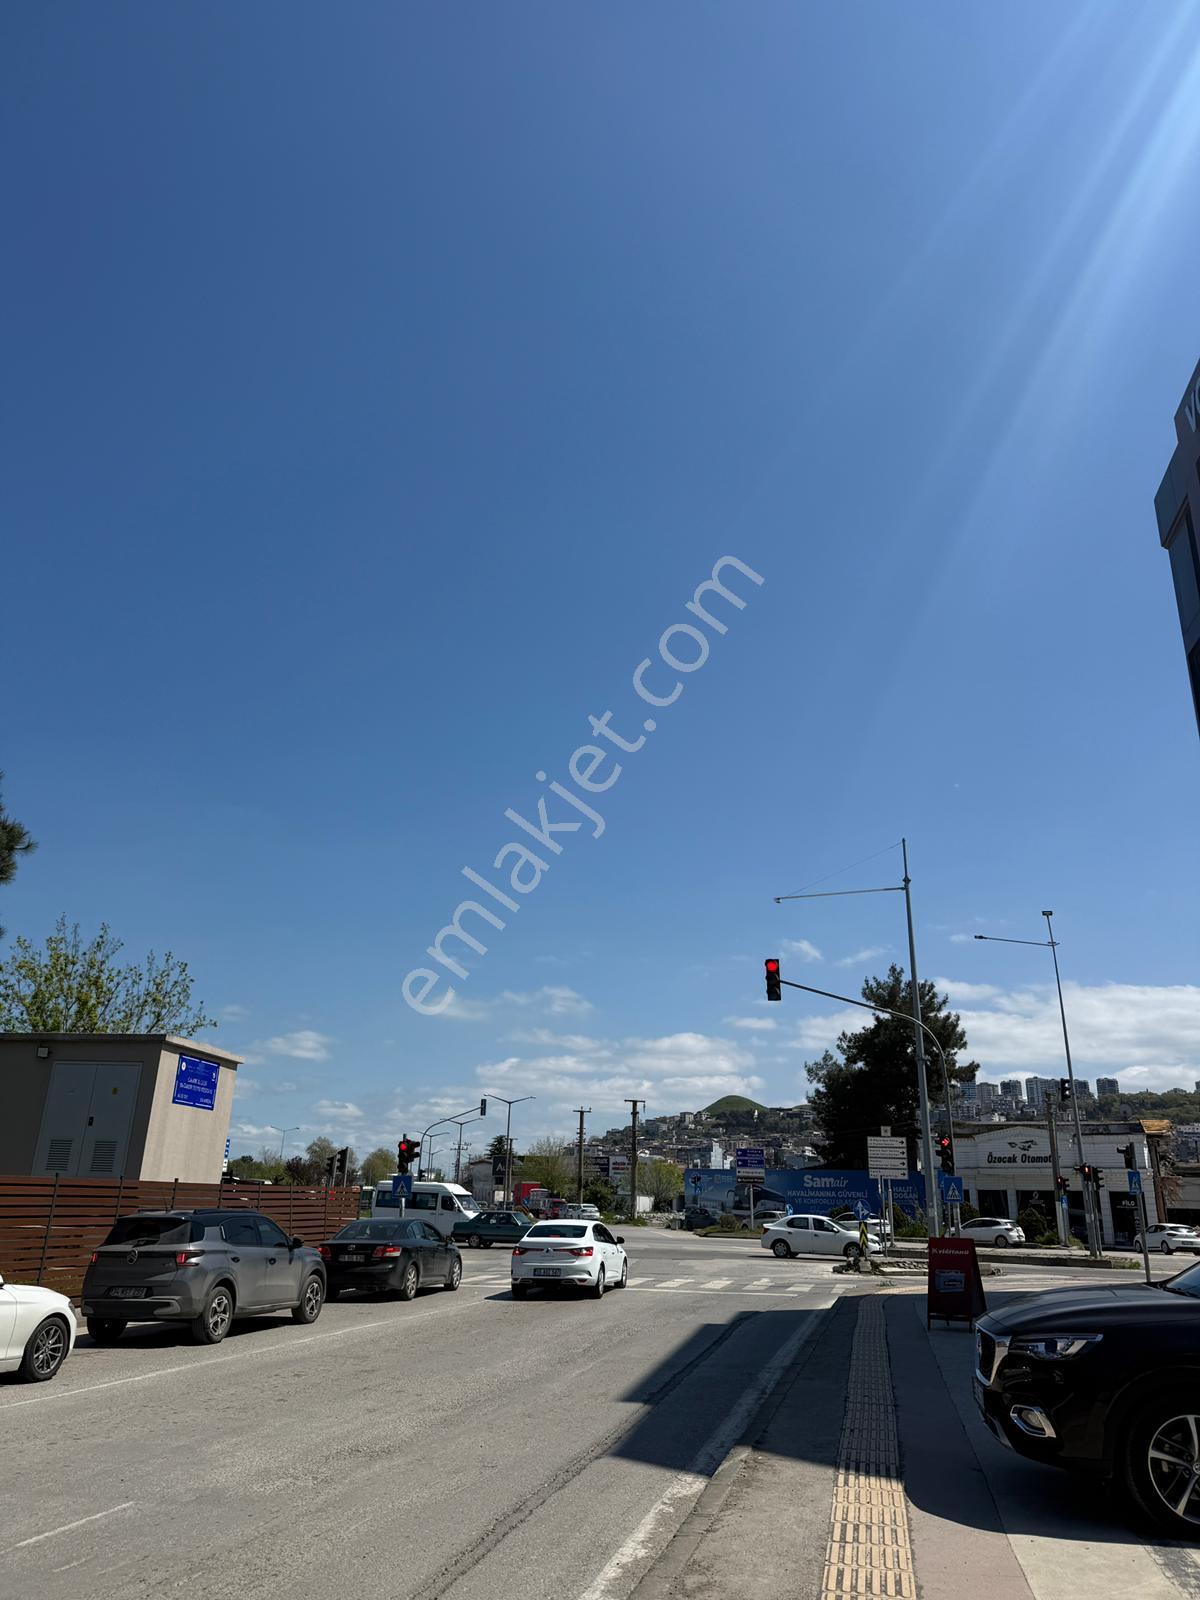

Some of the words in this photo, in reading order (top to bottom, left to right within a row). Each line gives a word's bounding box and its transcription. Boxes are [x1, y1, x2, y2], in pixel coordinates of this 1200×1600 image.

[987, 1152, 1017, 1164] Özocak
[1021, 1153, 1061, 1164] Otomot
[803, 1174, 848, 1188] Samair
